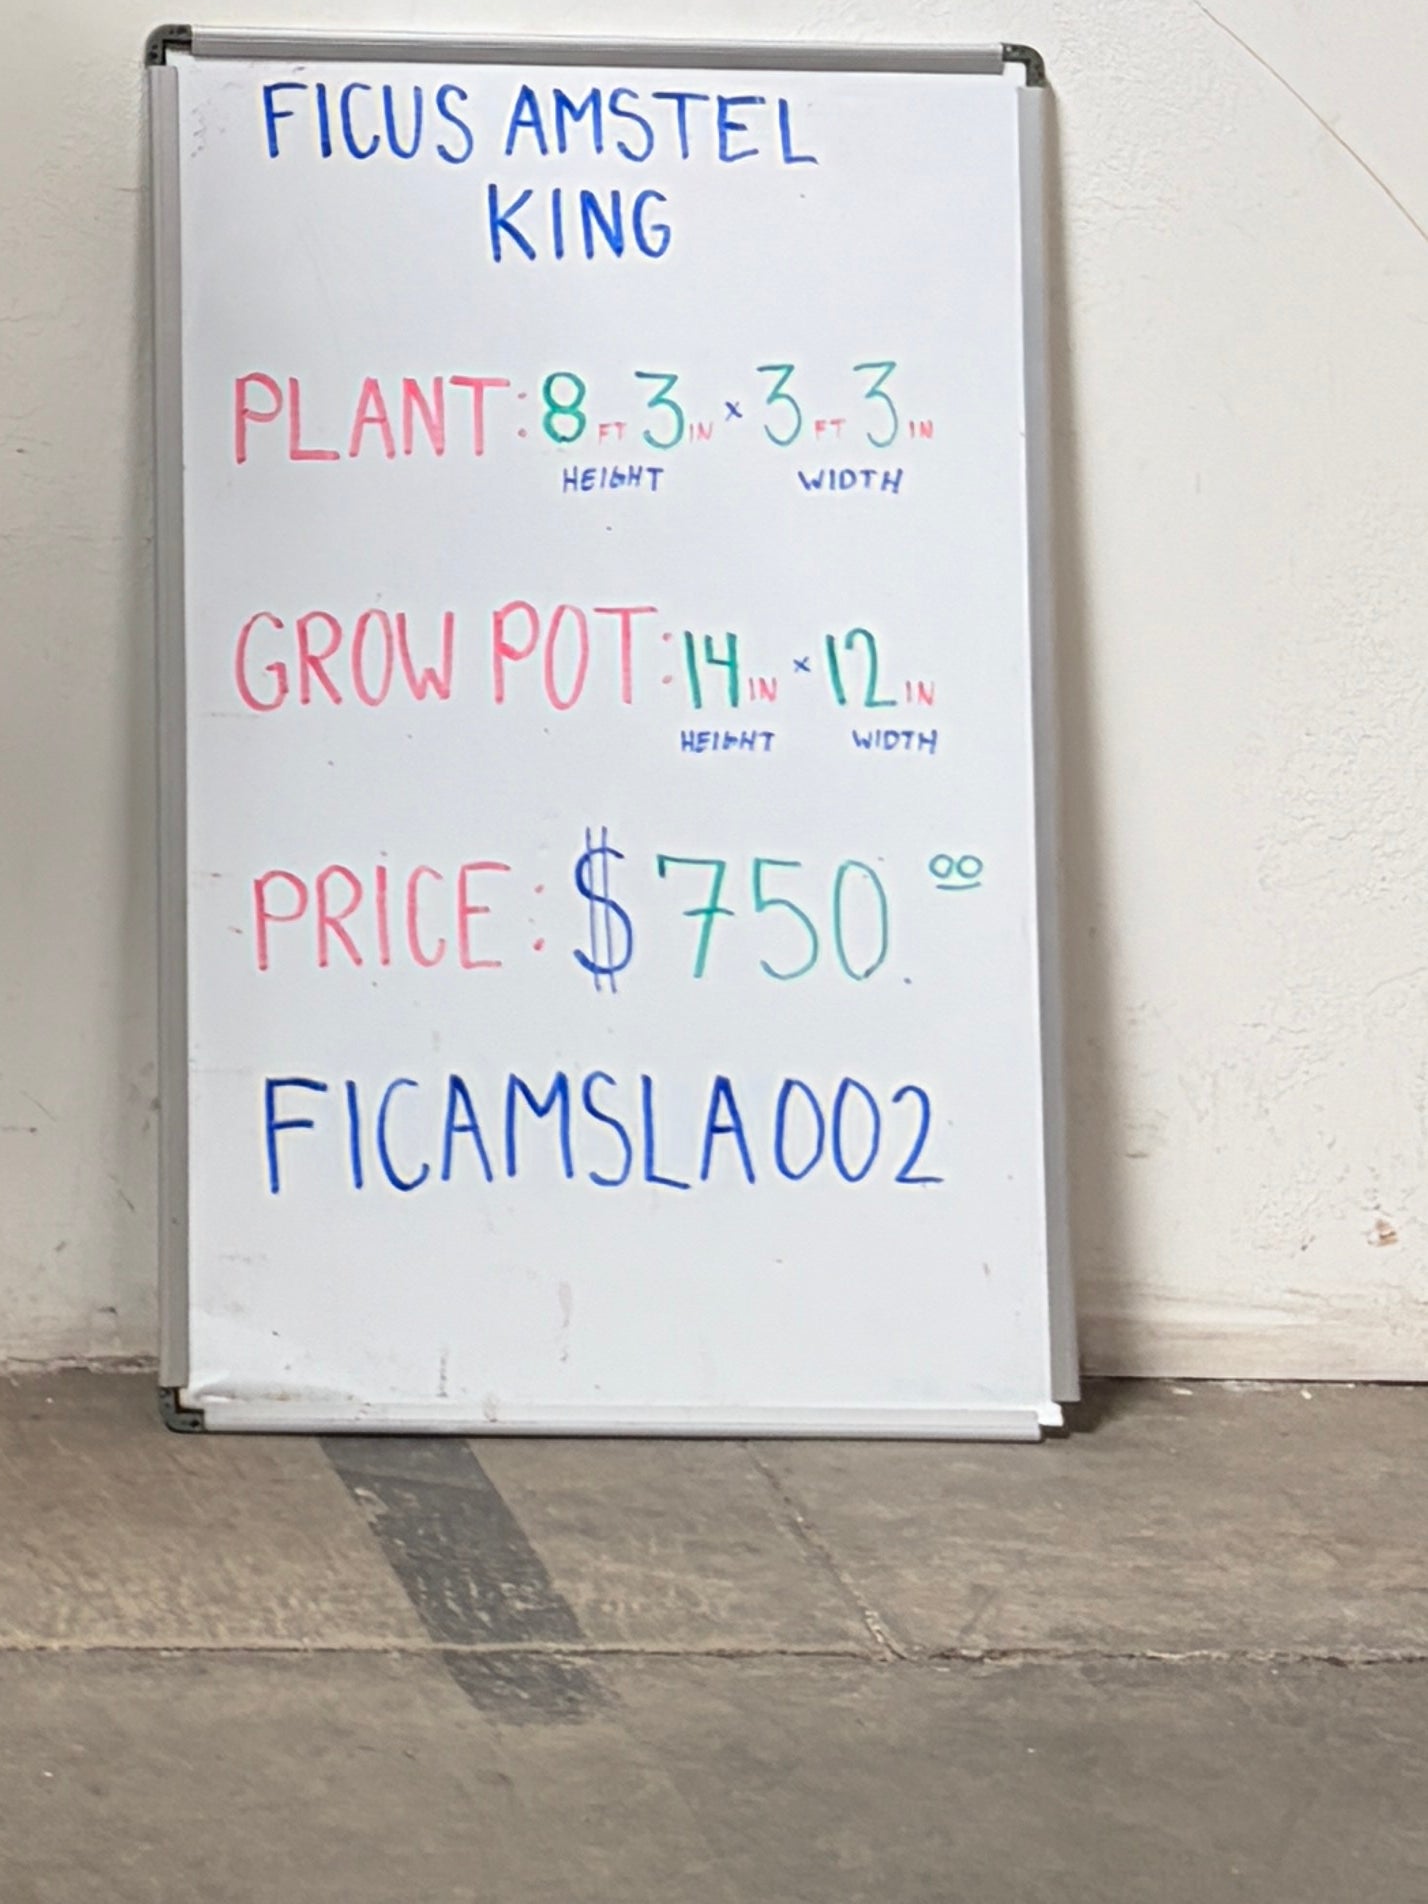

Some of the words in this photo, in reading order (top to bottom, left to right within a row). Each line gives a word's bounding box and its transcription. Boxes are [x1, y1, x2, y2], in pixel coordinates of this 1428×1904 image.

[261, 82, 475, 166] FICUS
[503, 84, 817, 165] AMSTEL
[487, 183, 672, 265] KING
[233, 372, 530, 465] PLANT:
[562, 466, 665, 493] HEIGHT
[797, 468, 904, 494] WIDTH
[234, 610, 455, 712] GROW
[680, 730, 775, 755] HEIGHT
[851, 729, 938, 755] WIDTH
[252, 860, 545, 971] PRICE:
[263, 1073, 946, 1196] FICAMSLA002
